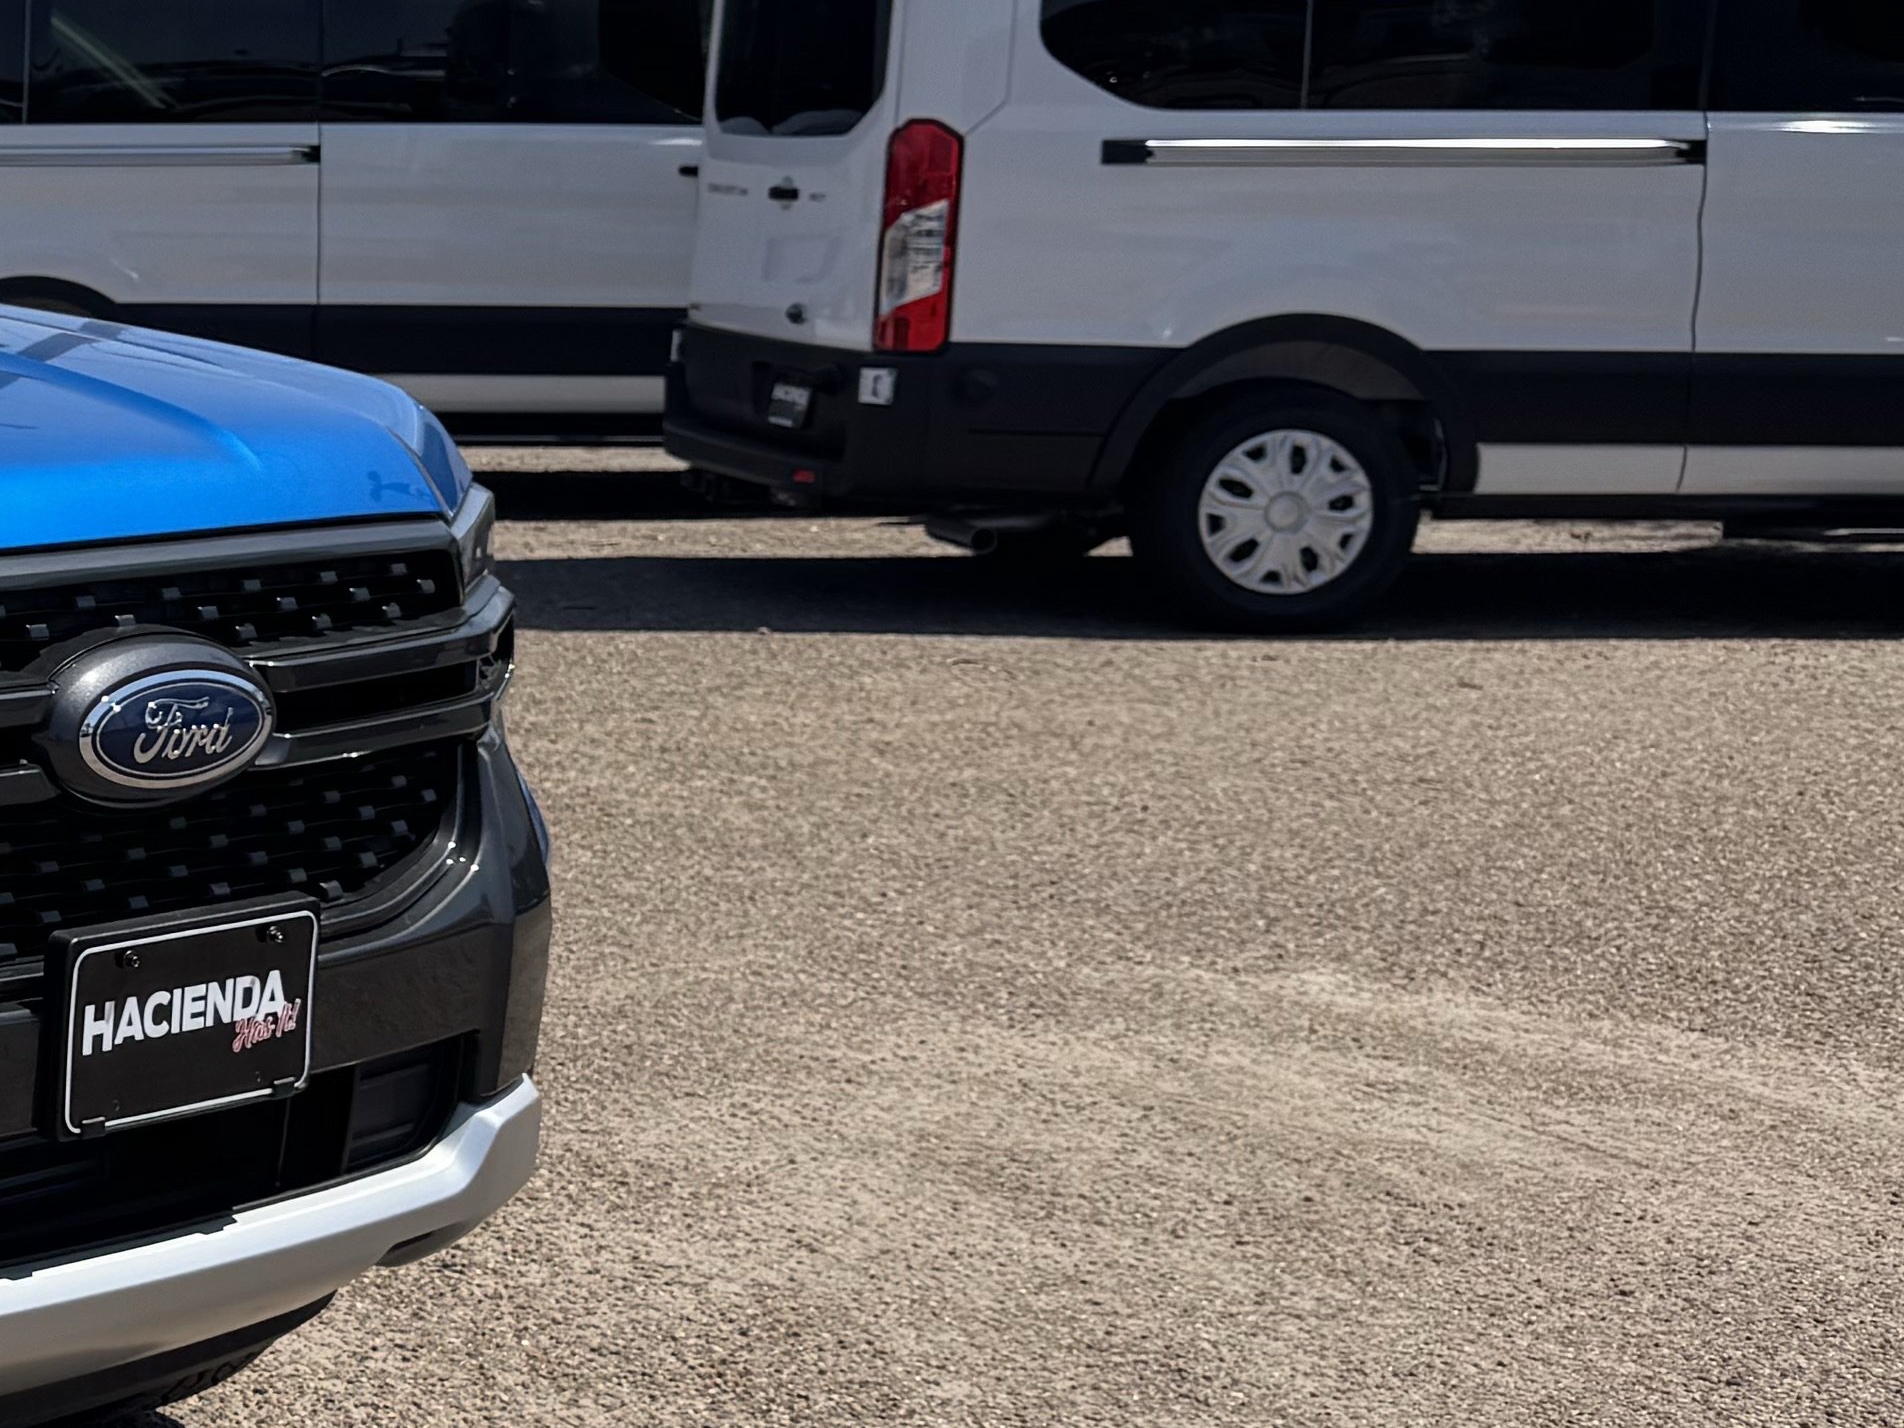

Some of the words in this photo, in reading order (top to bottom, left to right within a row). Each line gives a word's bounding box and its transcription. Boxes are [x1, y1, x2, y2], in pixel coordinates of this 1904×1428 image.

[132, 696, 234, 765] Ford
[81, 969, 286, 1057] HACIENDA
[231, 1015, 276, 1053] Has
